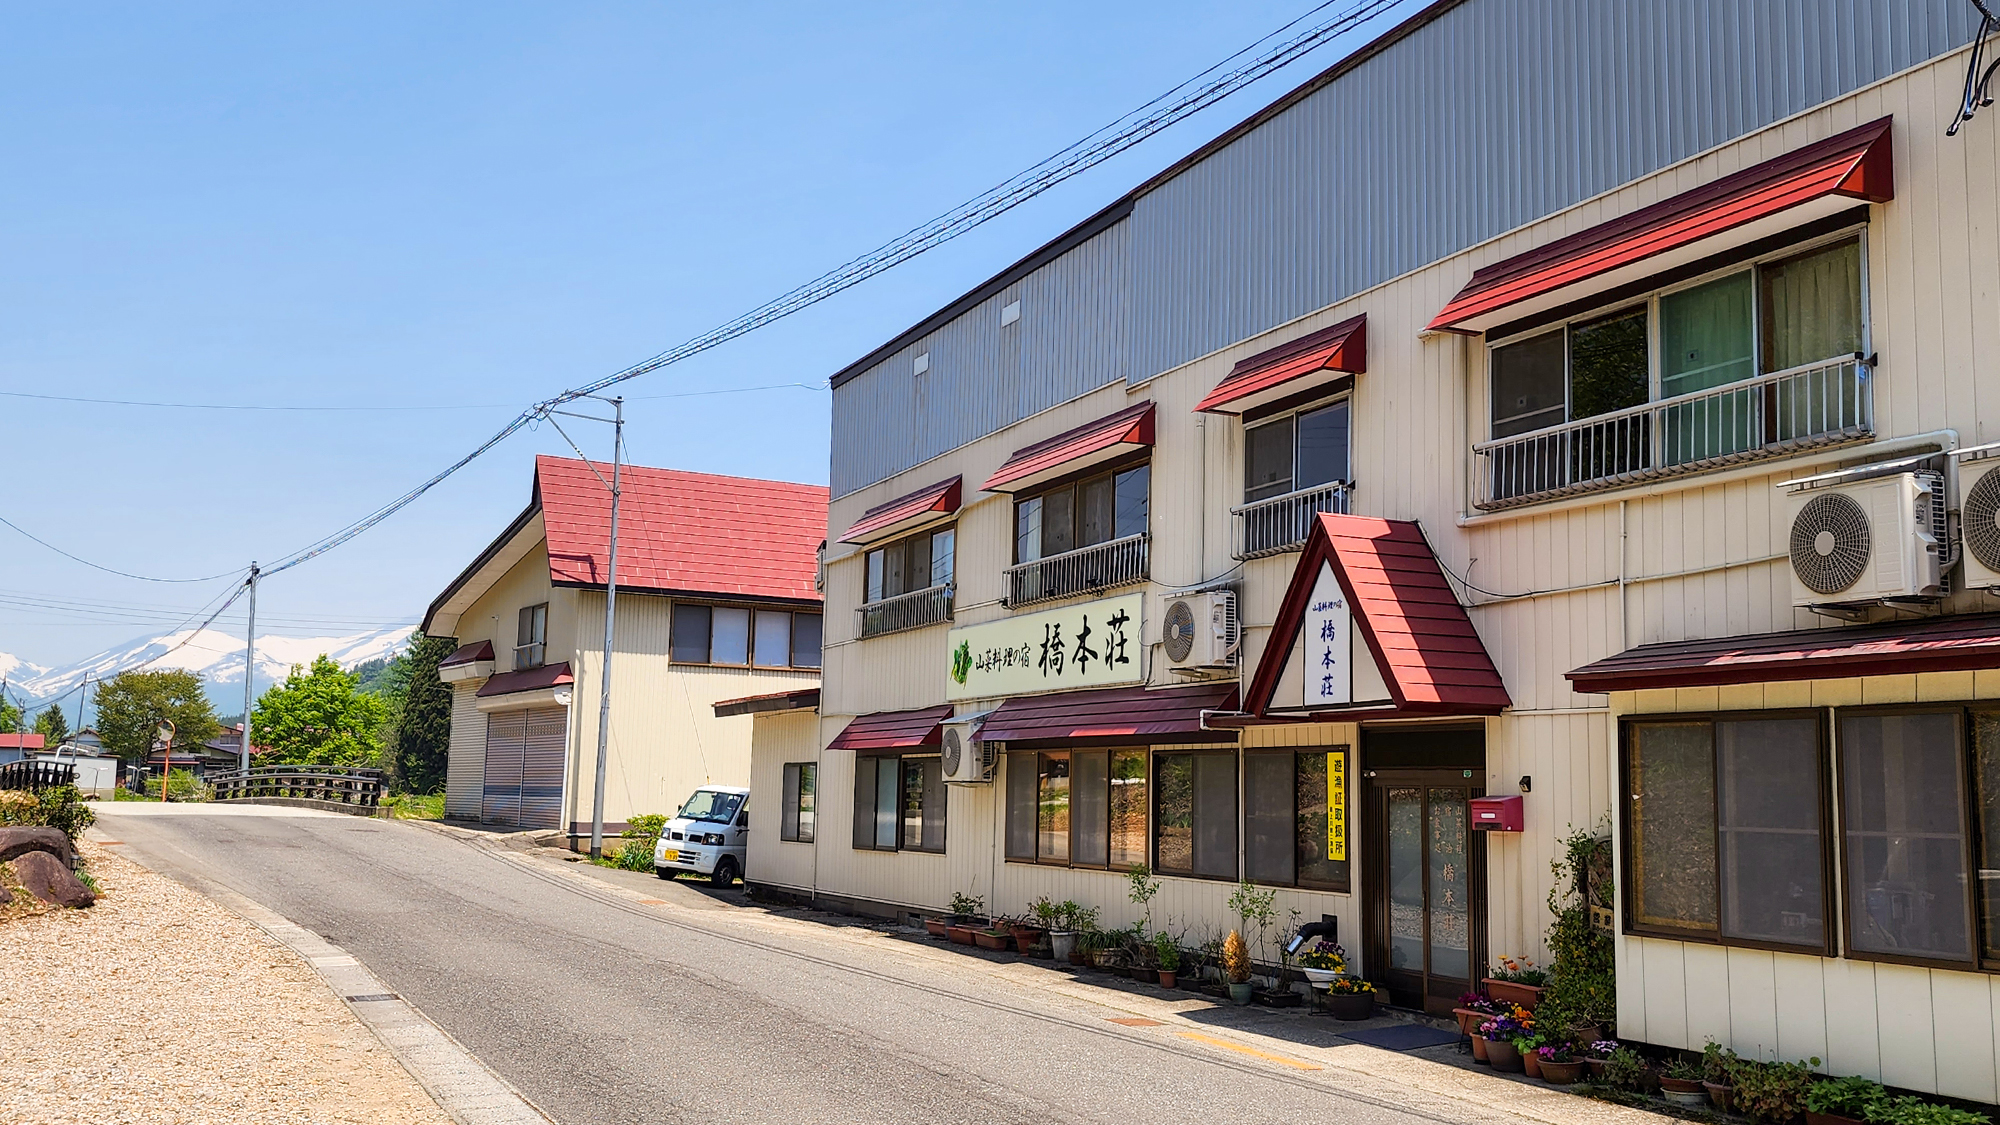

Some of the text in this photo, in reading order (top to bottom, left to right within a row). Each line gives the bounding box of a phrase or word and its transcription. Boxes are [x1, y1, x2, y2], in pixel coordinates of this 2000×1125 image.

[975, 608, 1131, 678] 山菜料理の宿 橋本荘
[1320, 619, 1336, 698] 橋本荘
[1441, 863, 1455, 931] 橋本荘
